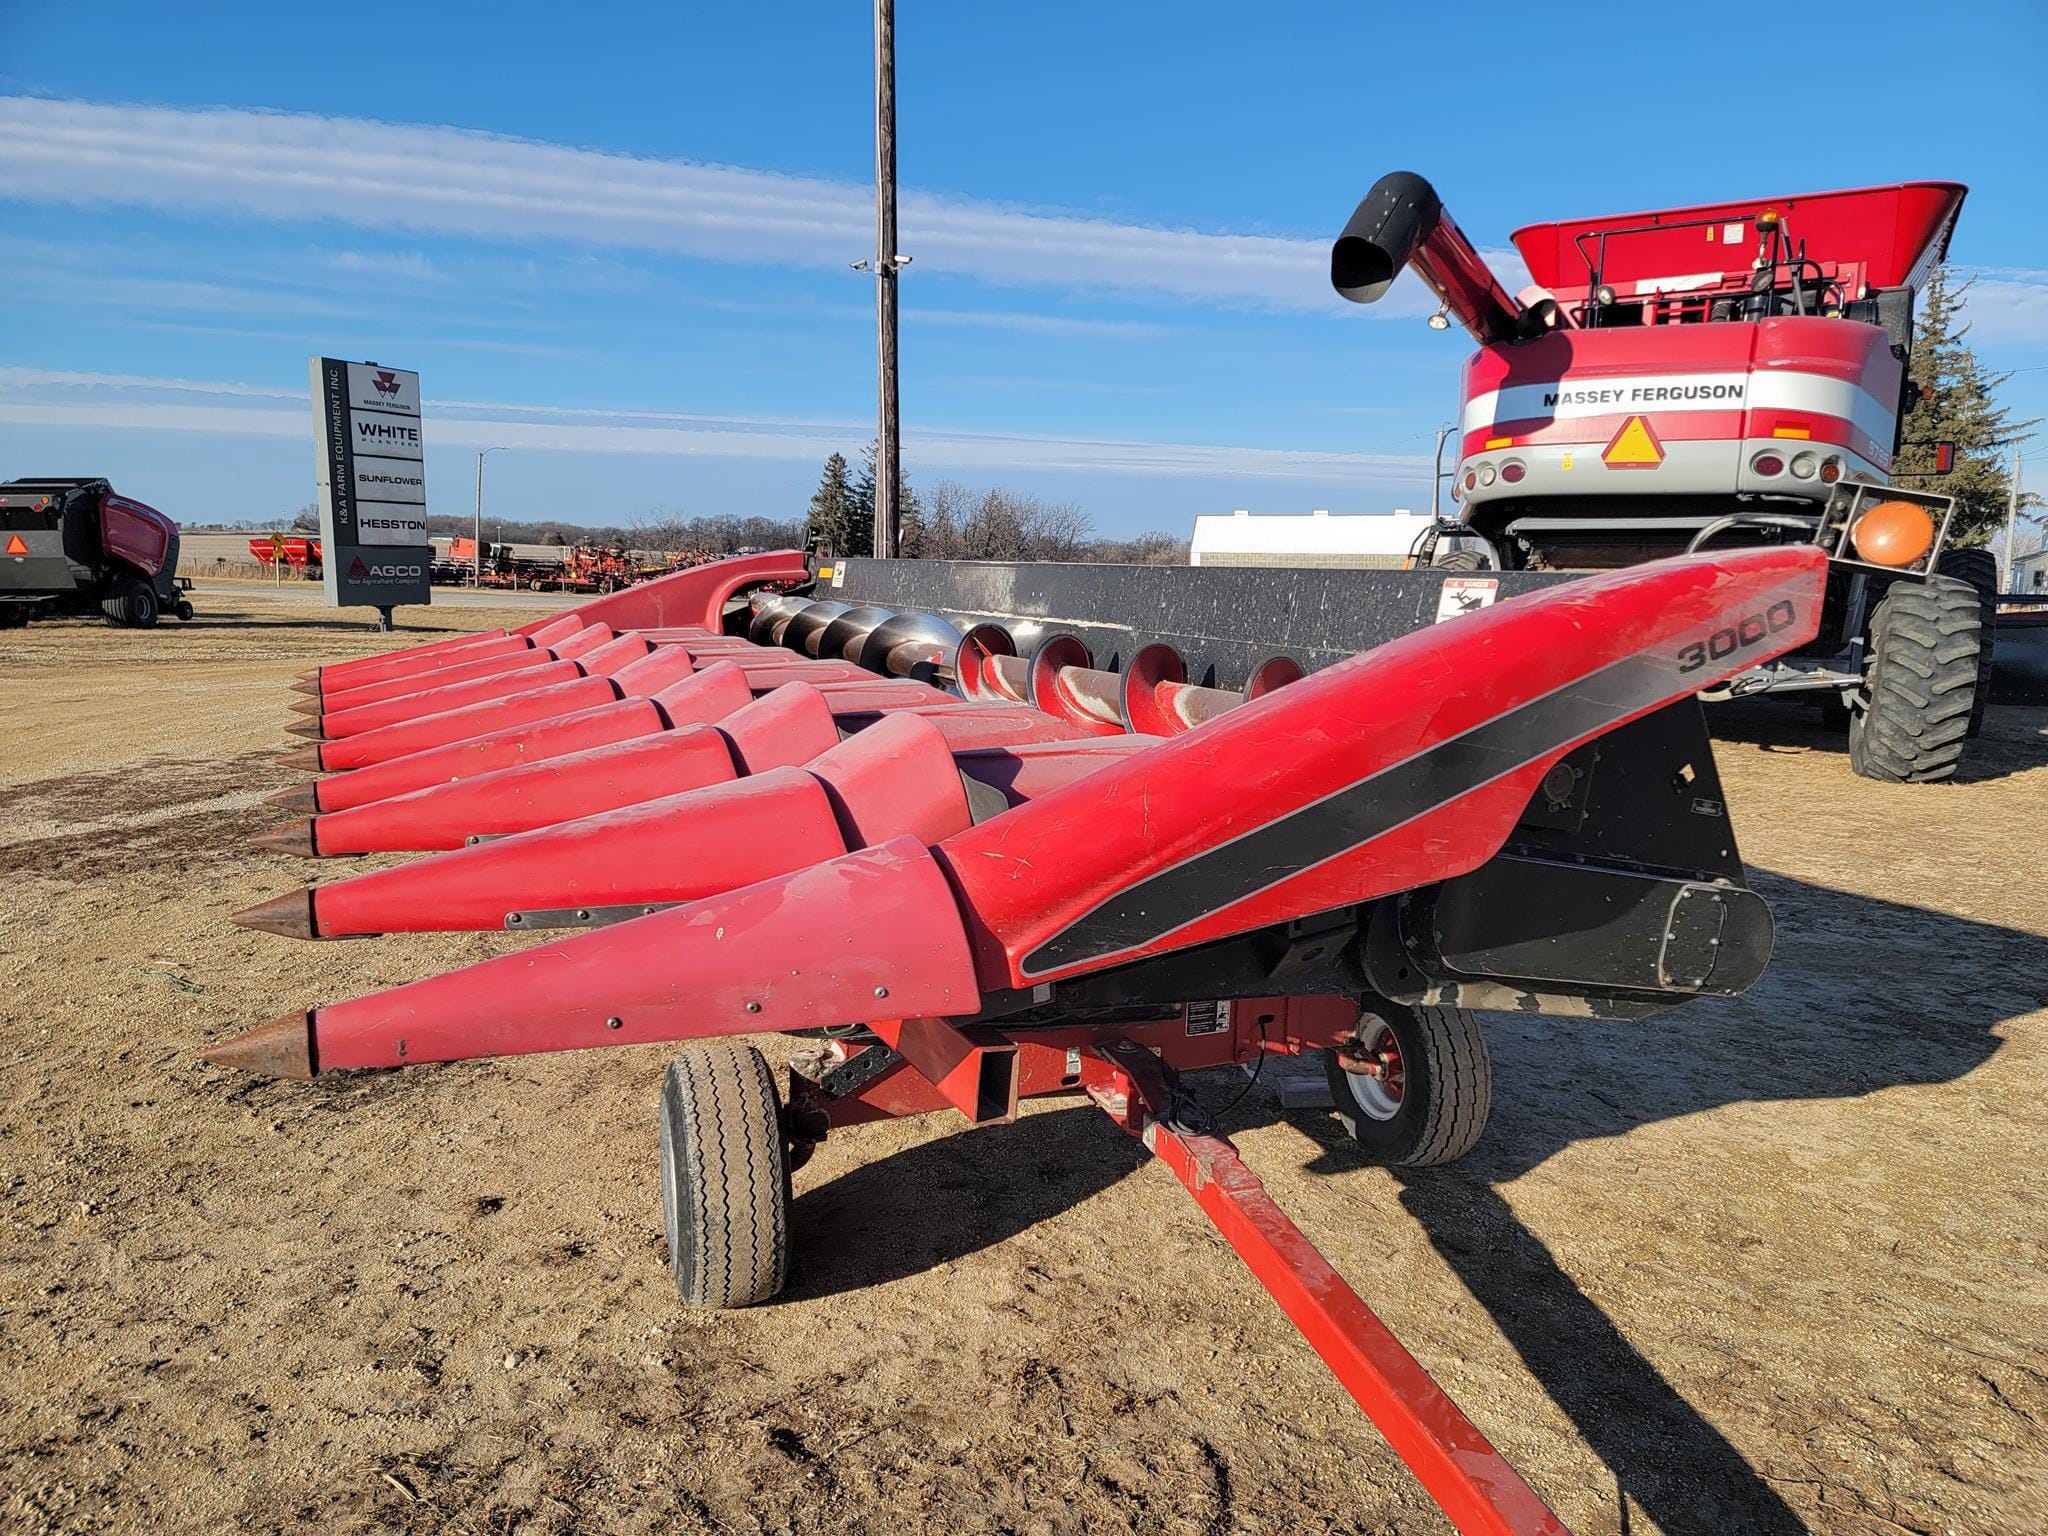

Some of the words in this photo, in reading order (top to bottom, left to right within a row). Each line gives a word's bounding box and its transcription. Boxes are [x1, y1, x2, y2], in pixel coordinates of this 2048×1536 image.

[1543, 389, 1624, 407] MASSEY
[1631, 384, 1744, 402] FERGUSON
[363, 399, 385, 407] MASSEY
[386, 402, 411, 411] FERGUSON
[331, 394, 344, 463] EQUIPMENT
[358, 422, 418, 441] WHITE
[361, 438, 419, 448] PLANTERS
[335, 464, 346, 496] FARM
[358, 474, 423, 486] SUNFLOWER
[338, 500, 349, 524] K&A
[360, 518, 426, 530] HESSTON
[369, 565, 422, 577] AGCO
[362, 578, 393, 586] Agriculture
[1678, 599, 1796, 675] 3000
